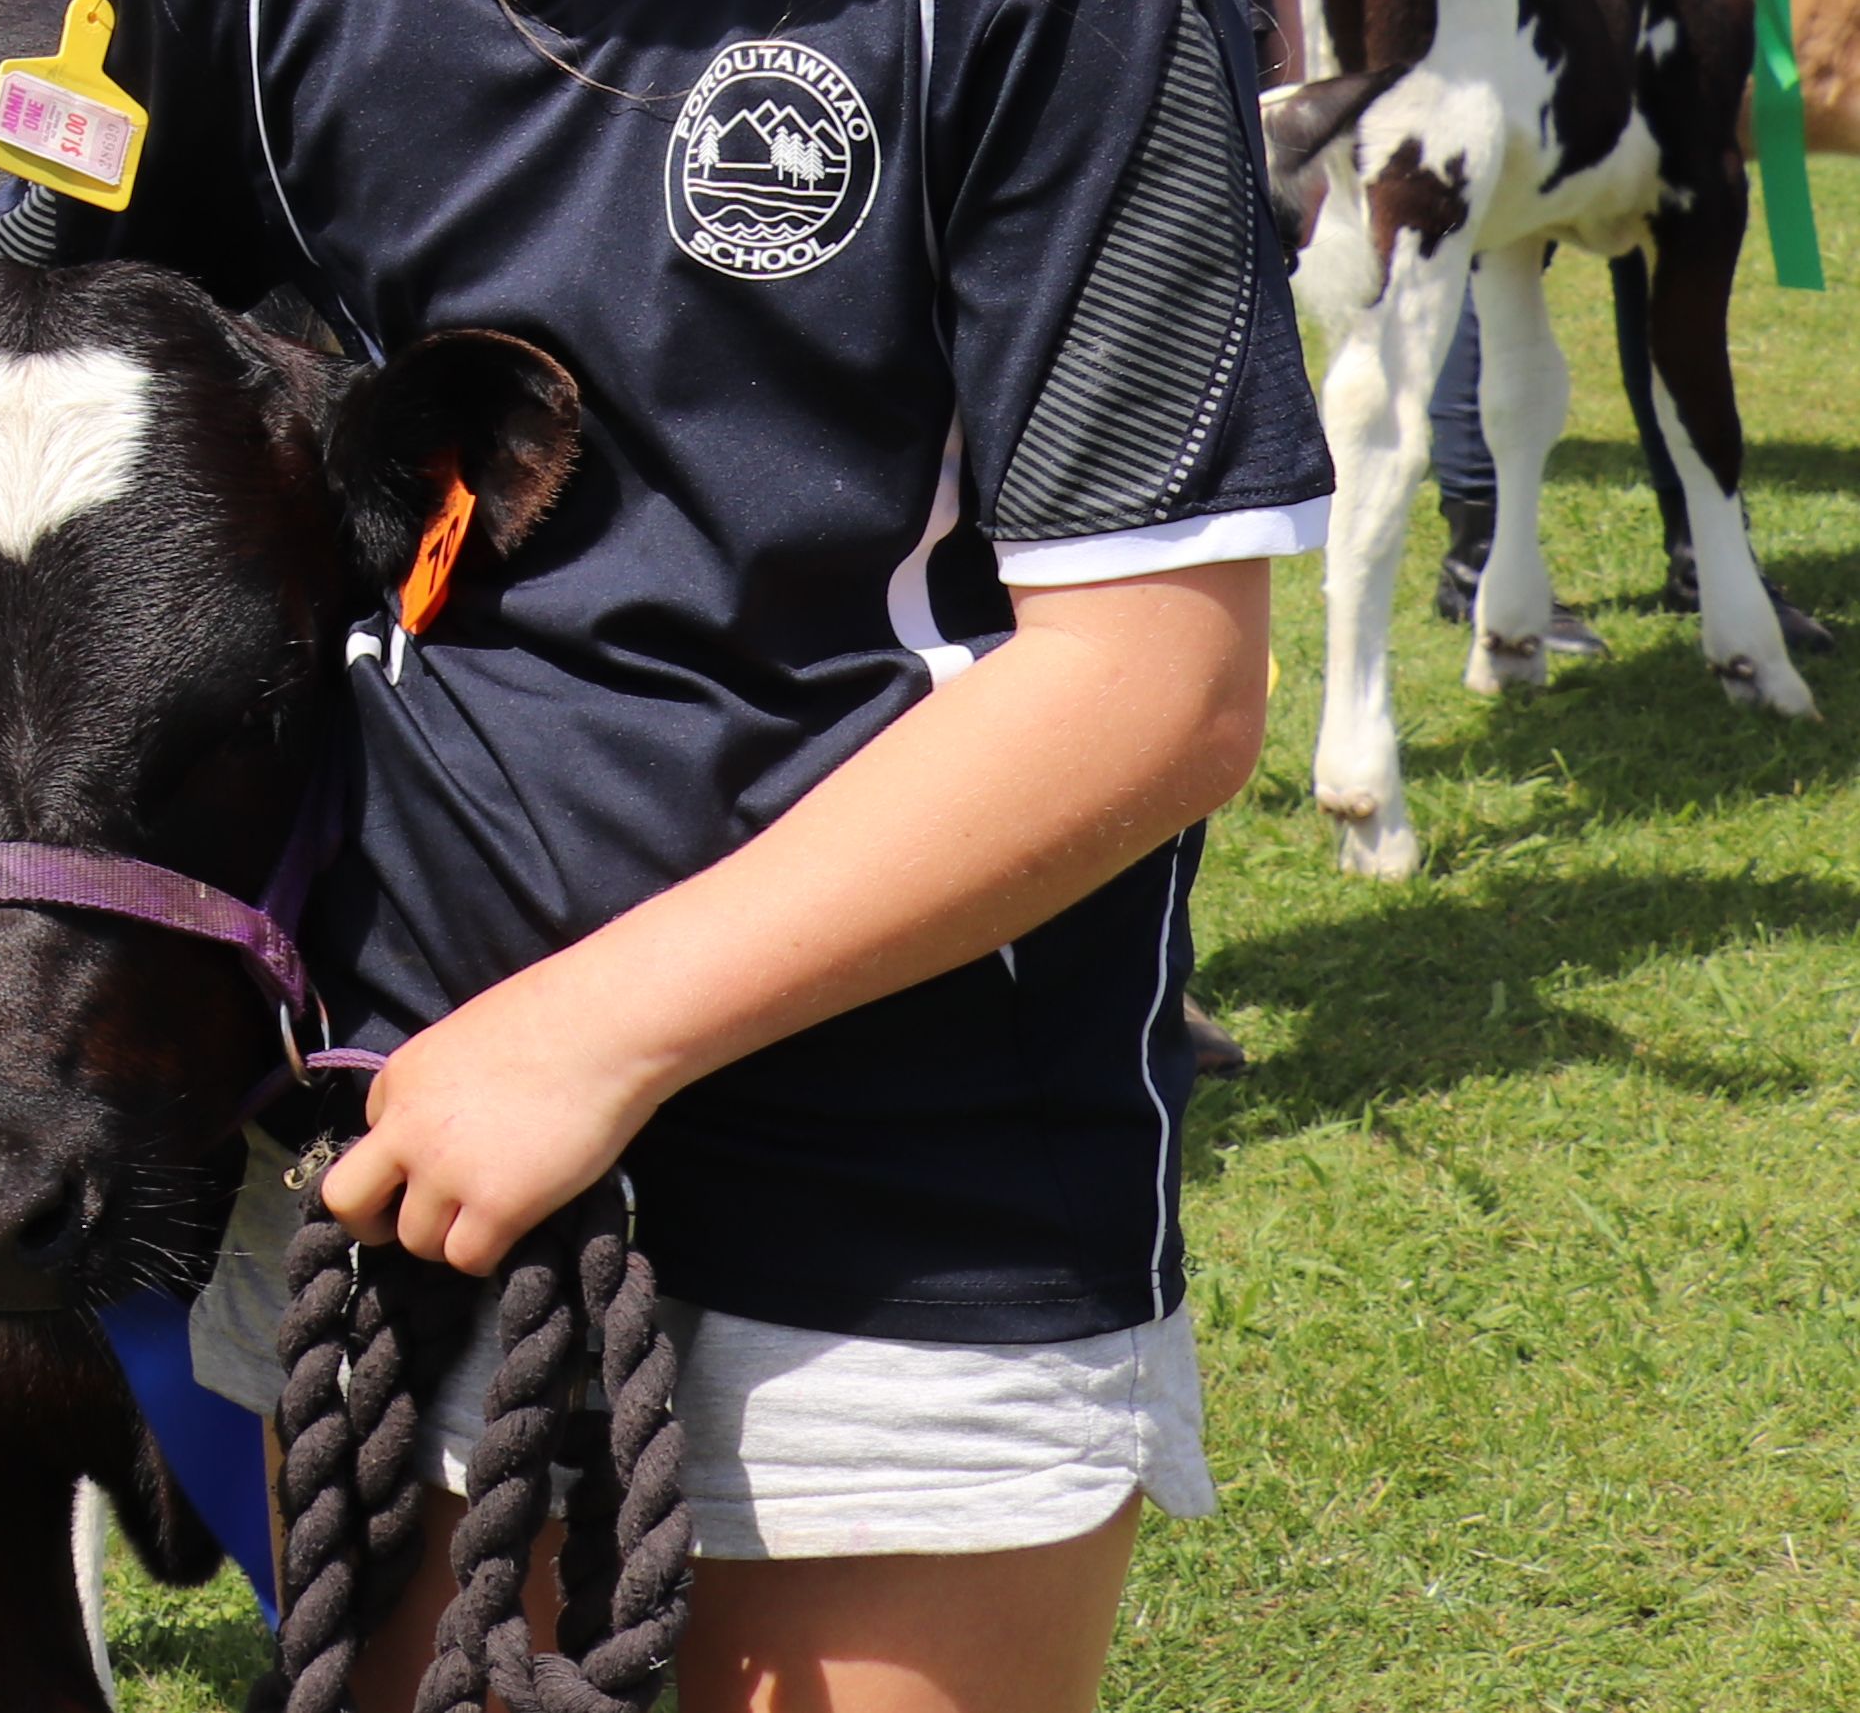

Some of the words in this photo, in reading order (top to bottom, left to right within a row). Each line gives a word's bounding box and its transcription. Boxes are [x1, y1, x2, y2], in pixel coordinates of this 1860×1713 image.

[1, 83, 26, 135] ADMIT
[23, 98, 45, 131] ONE
[677, 48, 870, 141] POROUTAWHAO
[60, 112, 88, 157] $1.00
[688, 230, 836, 271] SCHOOL
